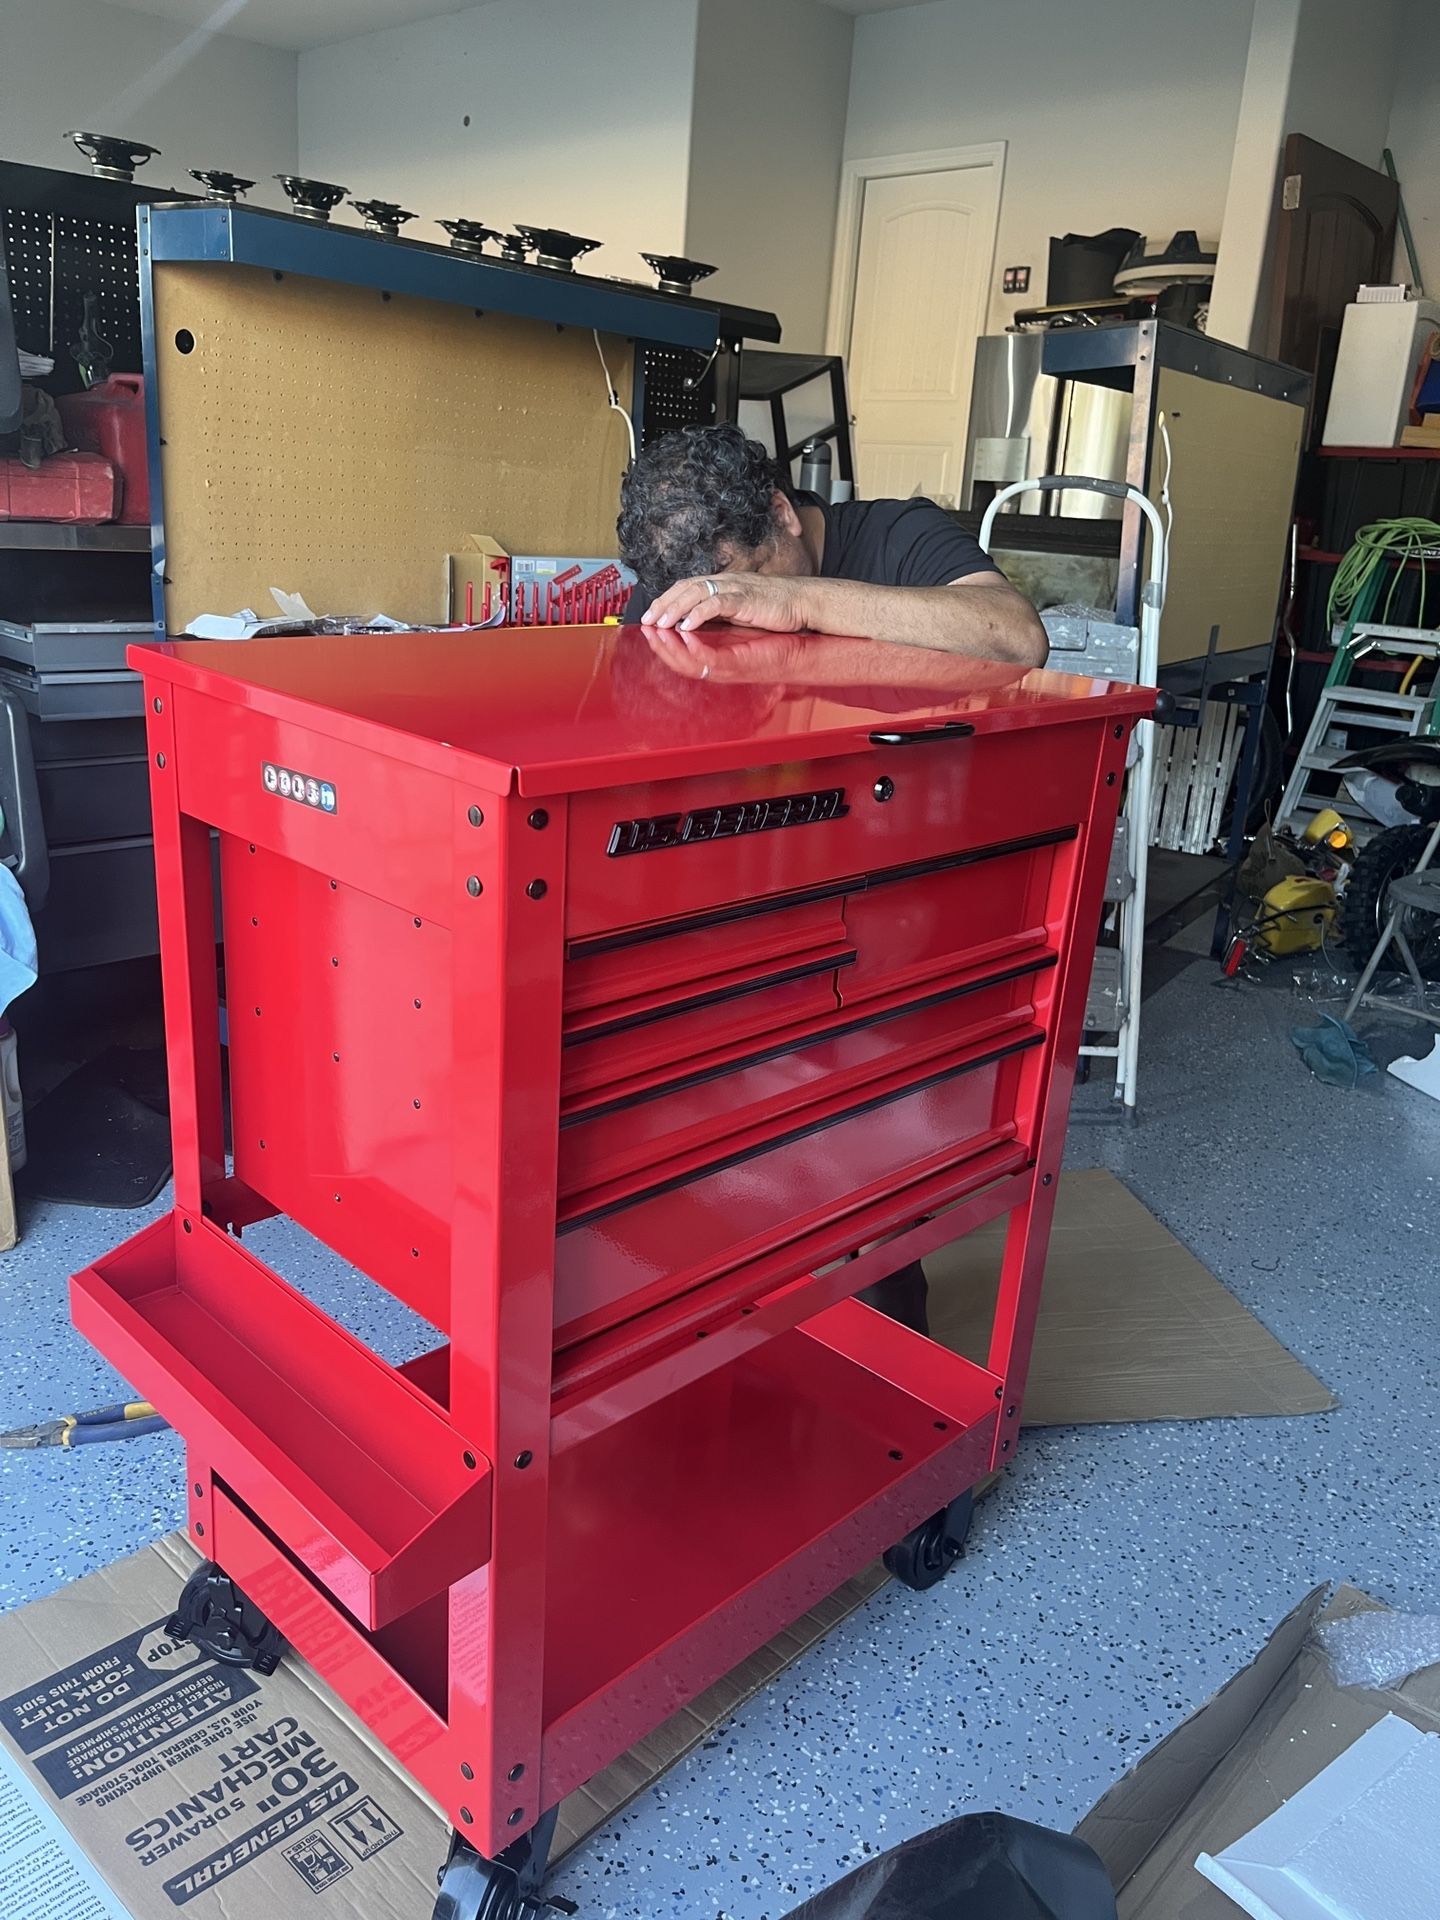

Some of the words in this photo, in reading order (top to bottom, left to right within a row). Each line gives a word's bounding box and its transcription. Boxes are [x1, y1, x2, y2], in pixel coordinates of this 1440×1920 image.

[82, 1656, 120, 1680] FROM
[49, 1678, 81, 1697] THIS
[72, 1664, 134, 1701] FORK
[97, 1683, 130, 1704] DO
[176, 1675, 214, 1698] BEFORE
[185, 1680, 224, 1705] INSPECT
[14, 1695, 46, 1716] SIDE
[21, 1699, 68, 1728] LIFT
[44, 1704, 91, 1732] NOT
[120, 1695, 174, 1727] ACCEPTING
[162, 1702, 183, 1716] FOR
[231, 1700, 262, 1718] YOUR
[73, 1687, 231, 1778] ATTENTION:
[113, 1714, 161, 1743] SHIPPING
[208, 1717, 230, 1730] U.S.
[233, 1714, 257, 1729] USE
[67, 1726, 119, 1757] SHIPMENT
[158, 1730, 207, 1758] GENERAL
[201, 1727, 232, 1747] CARE
[218, 1718, 298, 1773] CART
[67, 1741, 112, 1768] DAMAGE
[128, 1757, 159, 1774] TOOL
[166, 1744, 202, 1767] WHEN
[76, 1773, 128, 1806] STORAGE
[96, 1764, 166, 1806] UNPACKING
[126, 1730, 316, 1852] MECHANICS
[256, 1747, 338, 1813] 30"
[230, 1798, 245, 1811] 5
[306, 1780, 348, 1814] U.S.
[22, 1837, 57, 1860] Optimal
[138, 1806, 231, 1866] DRAWER
[304, 1832, 317, 1844] 100
[369, 1837, 385, 1850] END
[173, 1808, 304, 1893] GENERAL
[360, 1846, 372, 1856] UP
[38, 1878, 51, 1889] for
[48, 1878, 86, 1903] Charging
